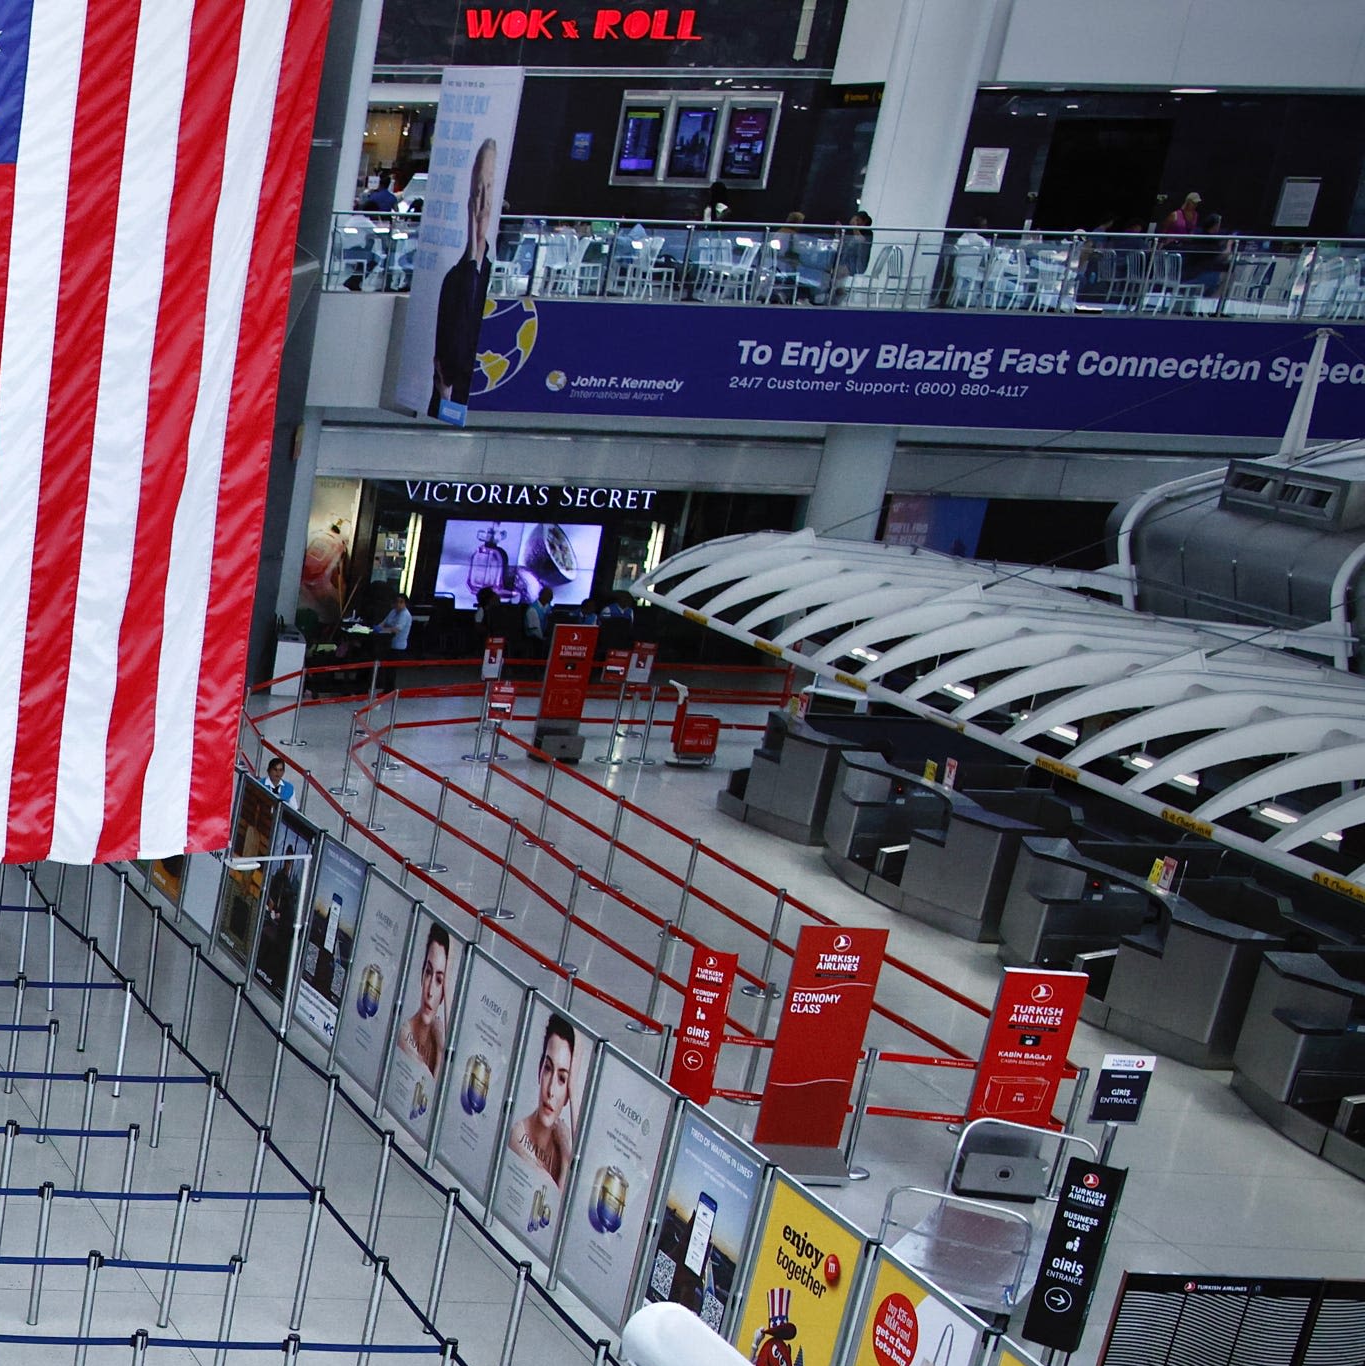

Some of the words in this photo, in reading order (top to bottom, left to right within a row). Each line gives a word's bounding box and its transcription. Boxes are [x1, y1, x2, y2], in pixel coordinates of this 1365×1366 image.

[466, 10, 557, 39] WOK
[593, 9, 703, 40] ROLL
[738, 340, 773, 365] To
[780, 341, 870, 374] Enjoy
[875, 343, 994, 379] Blazing
[999, 348, 1070, 374] Fast
[1077, 351, 1261, 381] Connection
[571, 376, 606, 388] John
[608, 377, 619, 388] F.
[621, 378, 683, 392] Kennedy
[729, 376, 763, 388] 24/7
[767, 377, 841, 391] Customer
[845, 380, 910, 395] Support:
[914, 382, 957, 396] (800)
[961, 384, 1028, 397] 880-4117
[569, 390, 631, 401] International
[633, 391, 664, 401] Airport
[405, 480, 549, 506] VICTORIA'S
[560, 486, 657, 510] SECRET
[819, 953, 860, 964] TURKISH
[696, 967, 724, 977] TURKISH
[816, 961, 858, 972] AIRLINES
[695, 973, 723, 983] AIRLINES
[692, 988, 719, 998] ECONOMY
[696, 995, 713, 1004] CLASS
[792, 992, 841, 1004] ECONOMY
[790, 1003, 822, 1014] CLASS
[1013, 1004, 1064, 1017] TURKISH
[1009, 1013, 1062, 1025] AIRLINES
[683, 1036, 710, 1048] ENTRANCE
[1100, 1097, 1137, 1105] ENTRANCE
[613, 1099, 642, 1125] SHISEIDO
[1067, 1192, 1105, 1207] AIRLINES
[1070, 1185, 1107, 1201] TURKISH
[1063, 1211, 1099, 1227] BUSINESS
[1067, 1219, 1091, 1232] CLASS
[783, 1224, 824, 1267] enjoy
[776, 1246, 827, 1299] together
[1052, 1256, 1084, 1276] GİRİŞ
[1046, 1269, 1084, 1286] ENTRANCE
